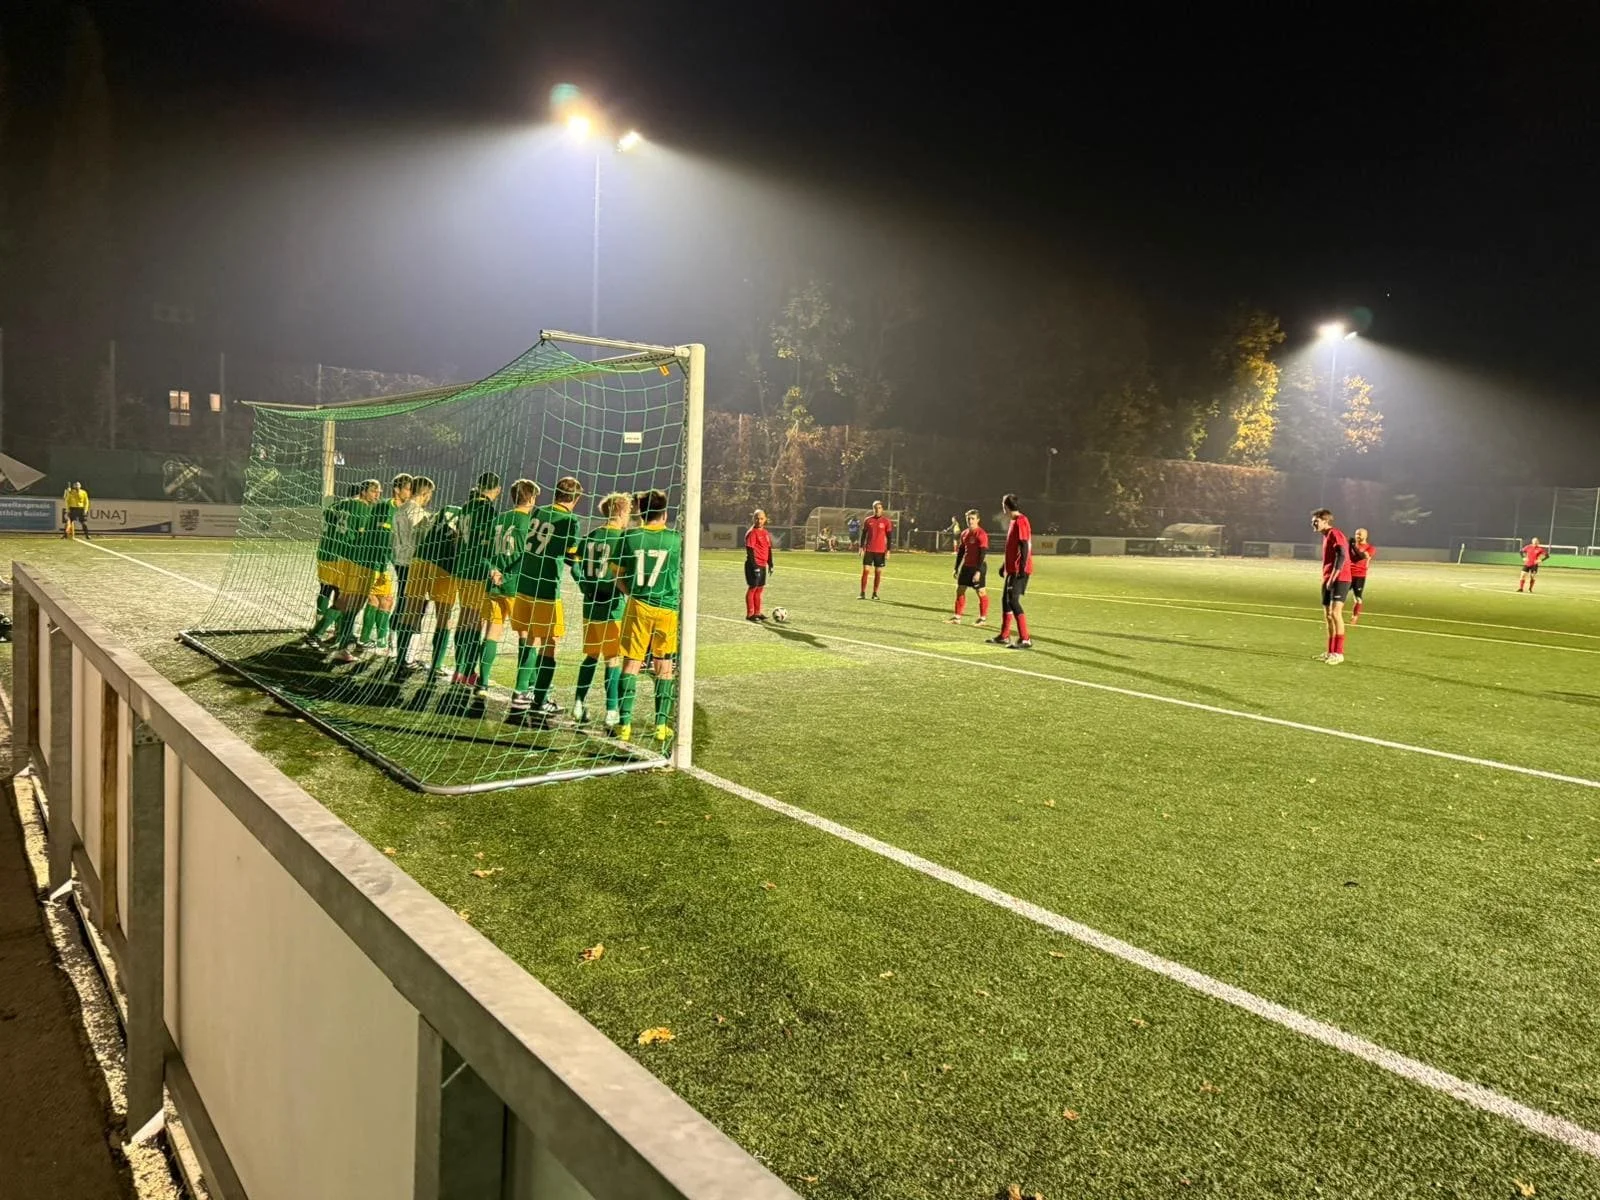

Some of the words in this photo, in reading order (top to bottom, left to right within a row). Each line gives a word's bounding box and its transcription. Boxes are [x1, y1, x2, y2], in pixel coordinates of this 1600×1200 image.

[494, 524, 516, 556] 16
[525, 518, 555, 554] 29
[587, 541, 611, 578] 13
[634, 549, 668, 587] 17
